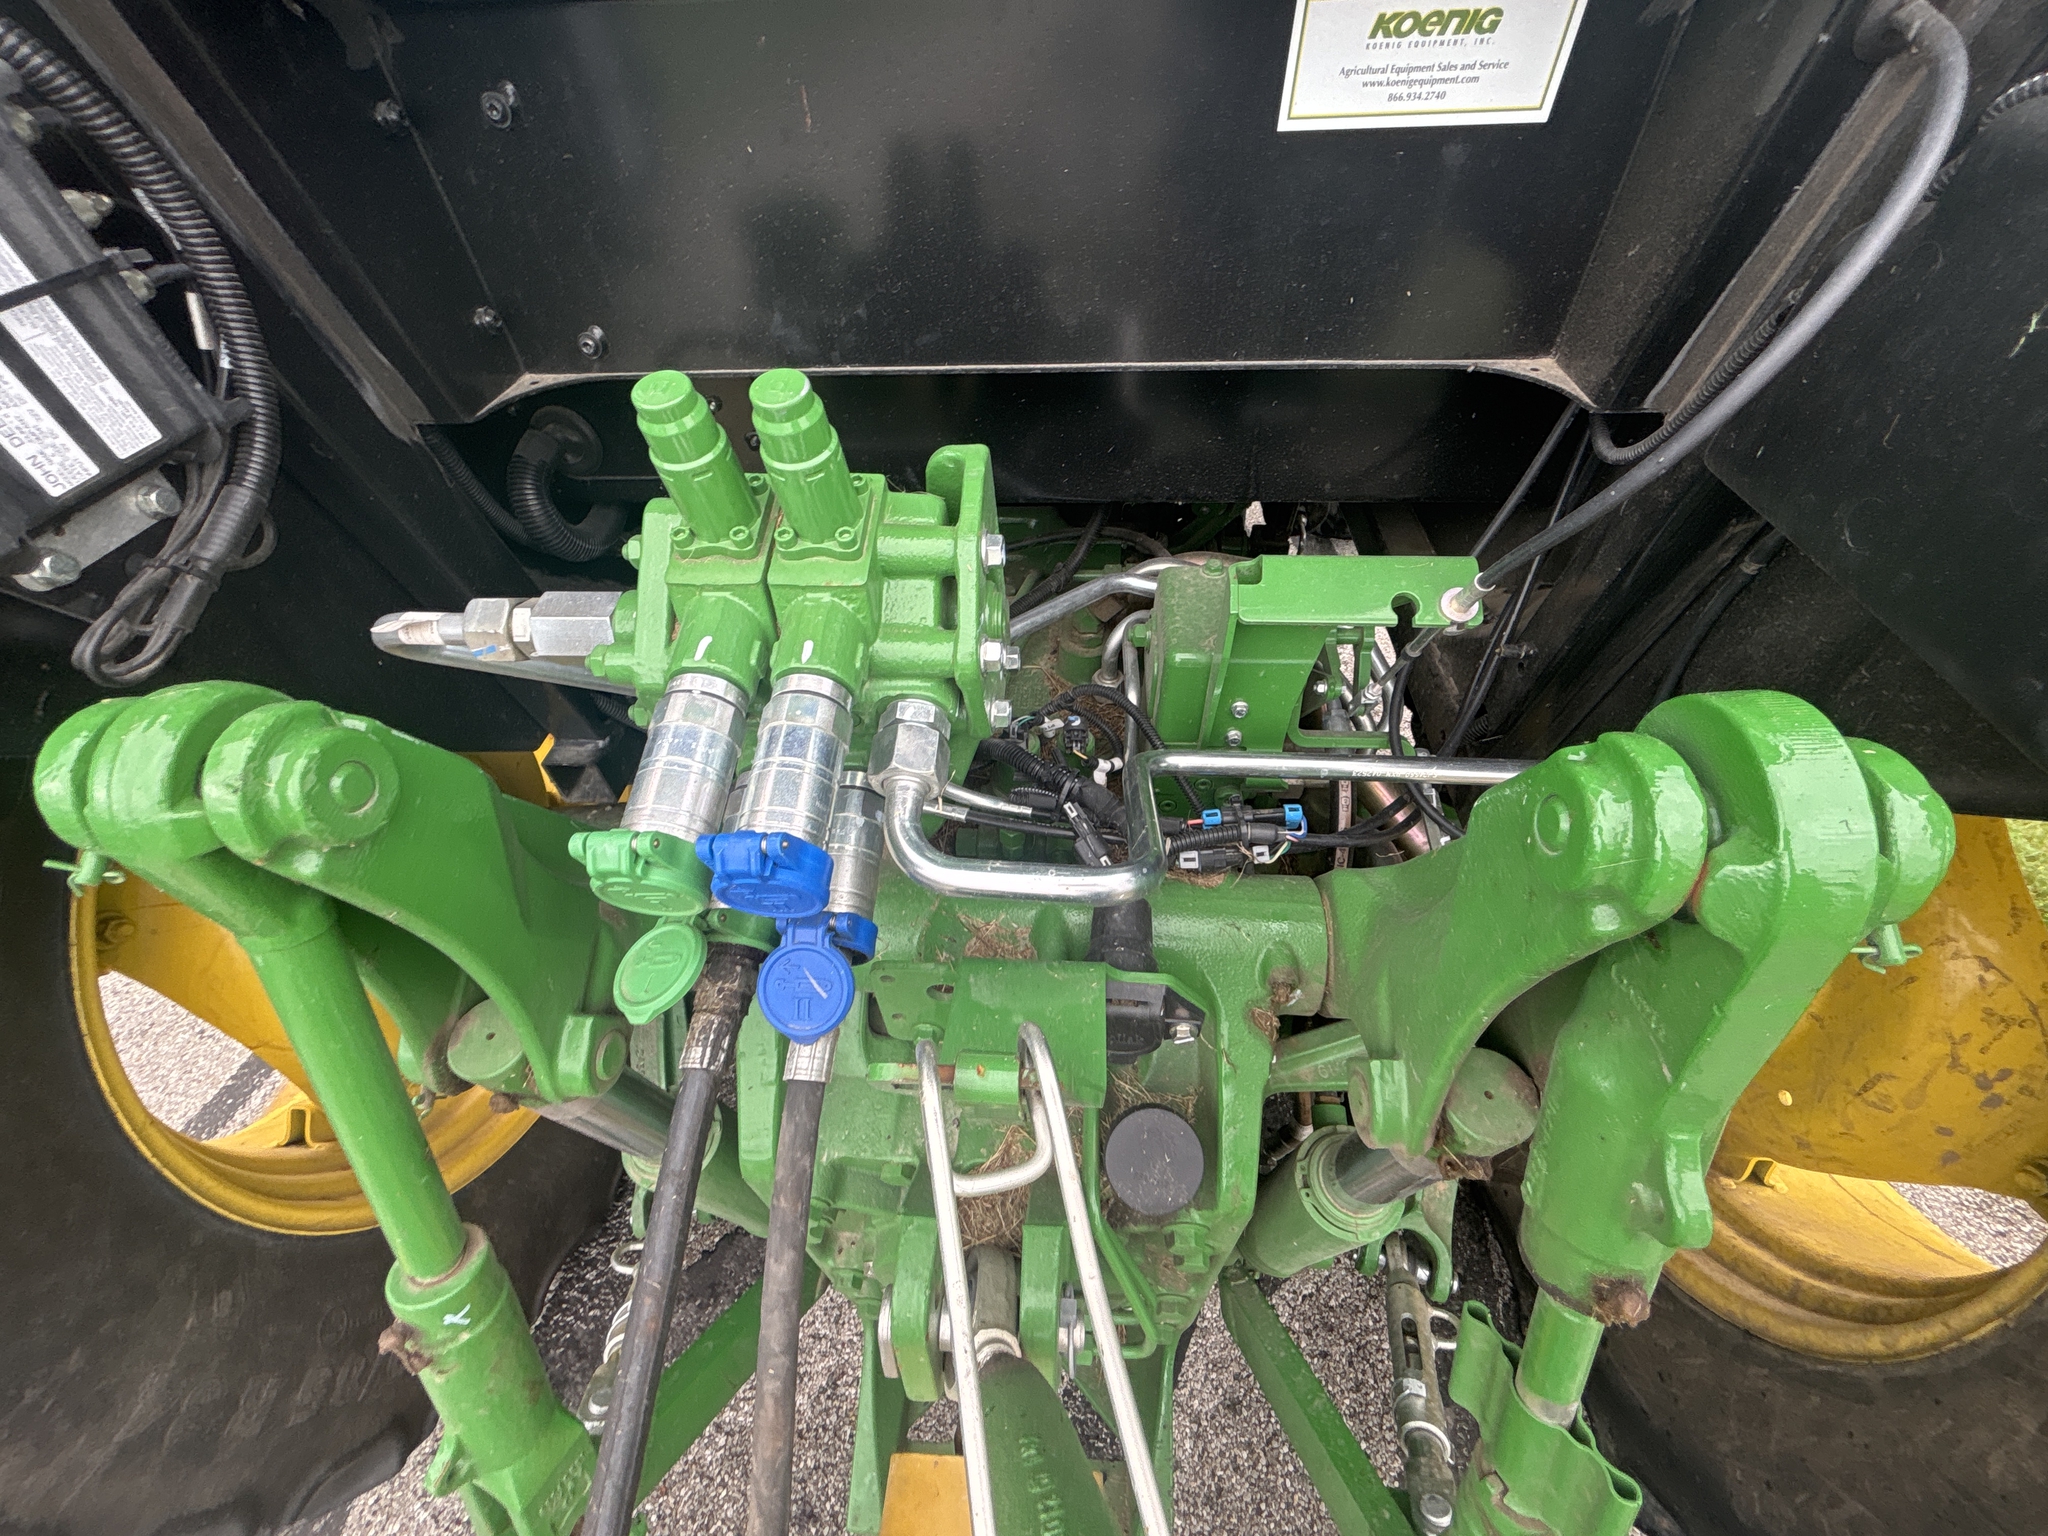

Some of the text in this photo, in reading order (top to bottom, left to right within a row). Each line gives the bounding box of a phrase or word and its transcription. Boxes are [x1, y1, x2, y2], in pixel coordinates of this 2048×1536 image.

[1365, 36, 1496, 51] KOENIG EQUIPMENT, INC.
[1338, 58, 1510, 79] Agricultural Equipment Sales and Service
[1361, 75, 1480, 89] www.koenigequipment.com
[1387, 90, 1447, 102] 866.934.2740
[24, 454, 67, 490] JOHN
